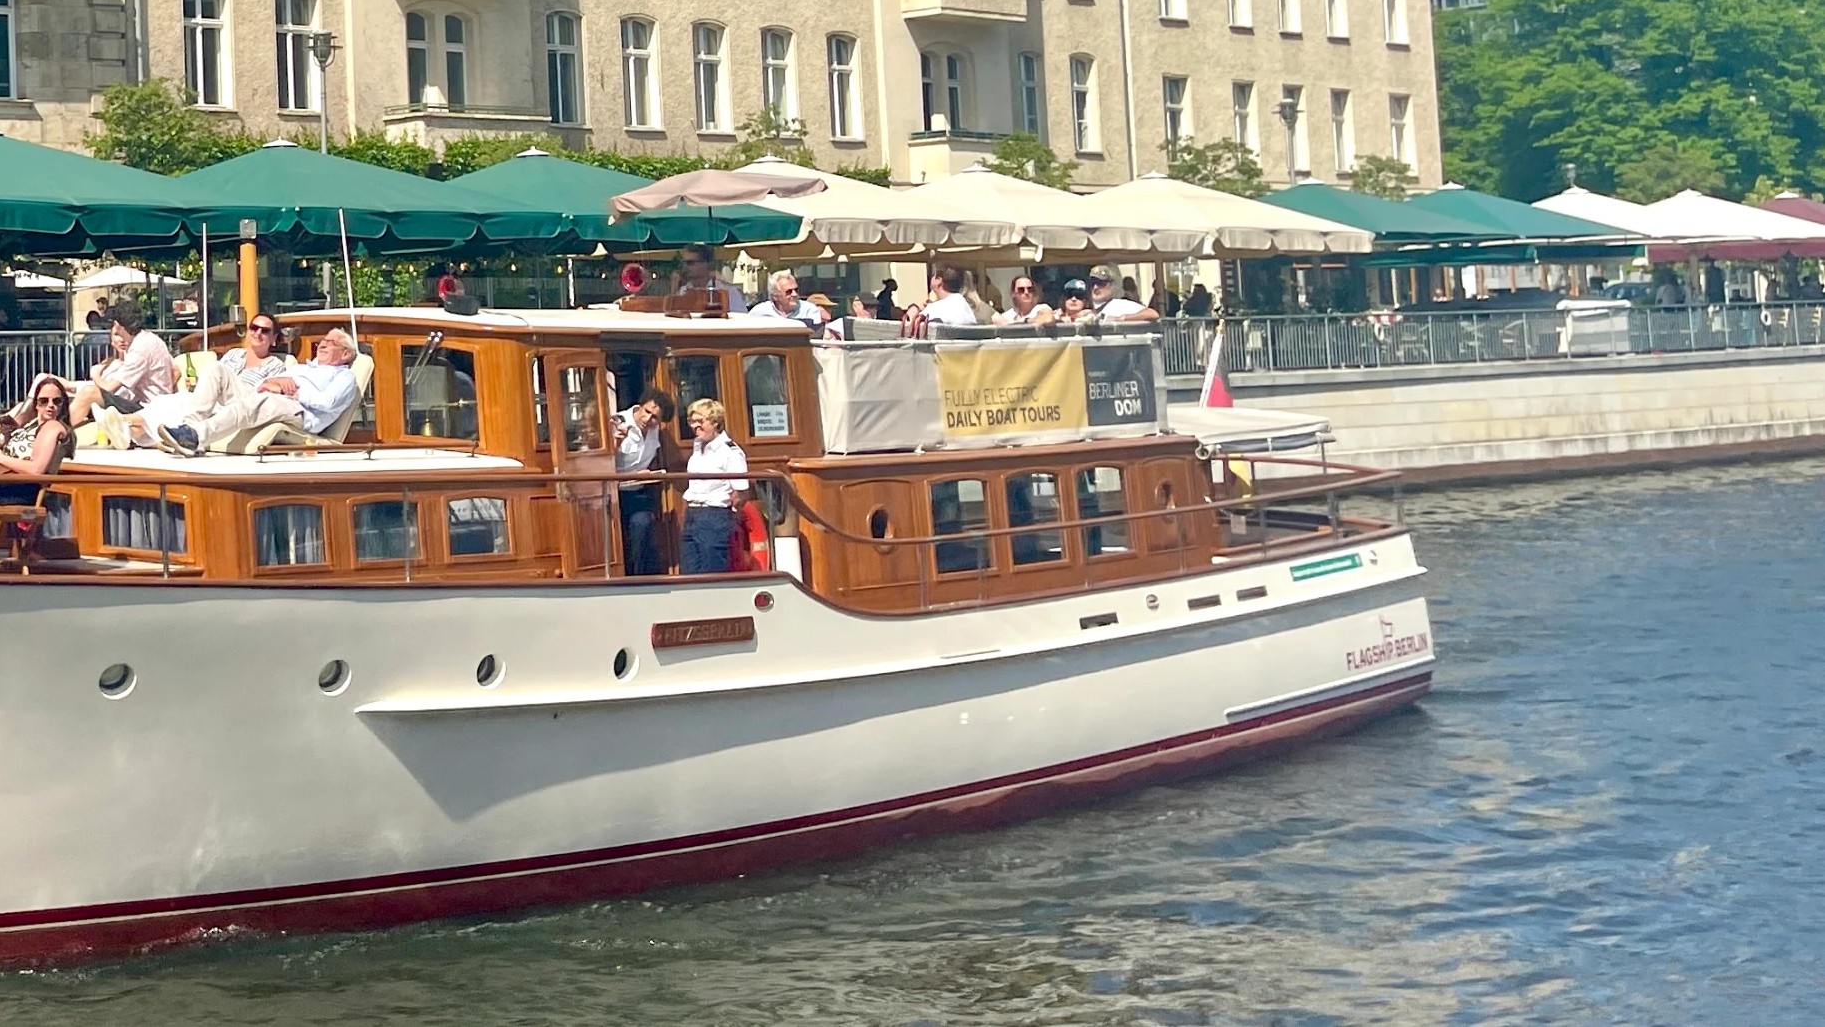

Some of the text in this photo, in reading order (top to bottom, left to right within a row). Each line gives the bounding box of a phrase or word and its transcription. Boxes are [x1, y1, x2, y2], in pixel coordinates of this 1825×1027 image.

[944, 385, 1040, 407] FULLY ELECTRIC
[1088, 380, 1140, 400] BERLINER
[946, 405, 1061, 429] DAILY BOAT TOURS
[1113, 398, 1143, 417] DOM
